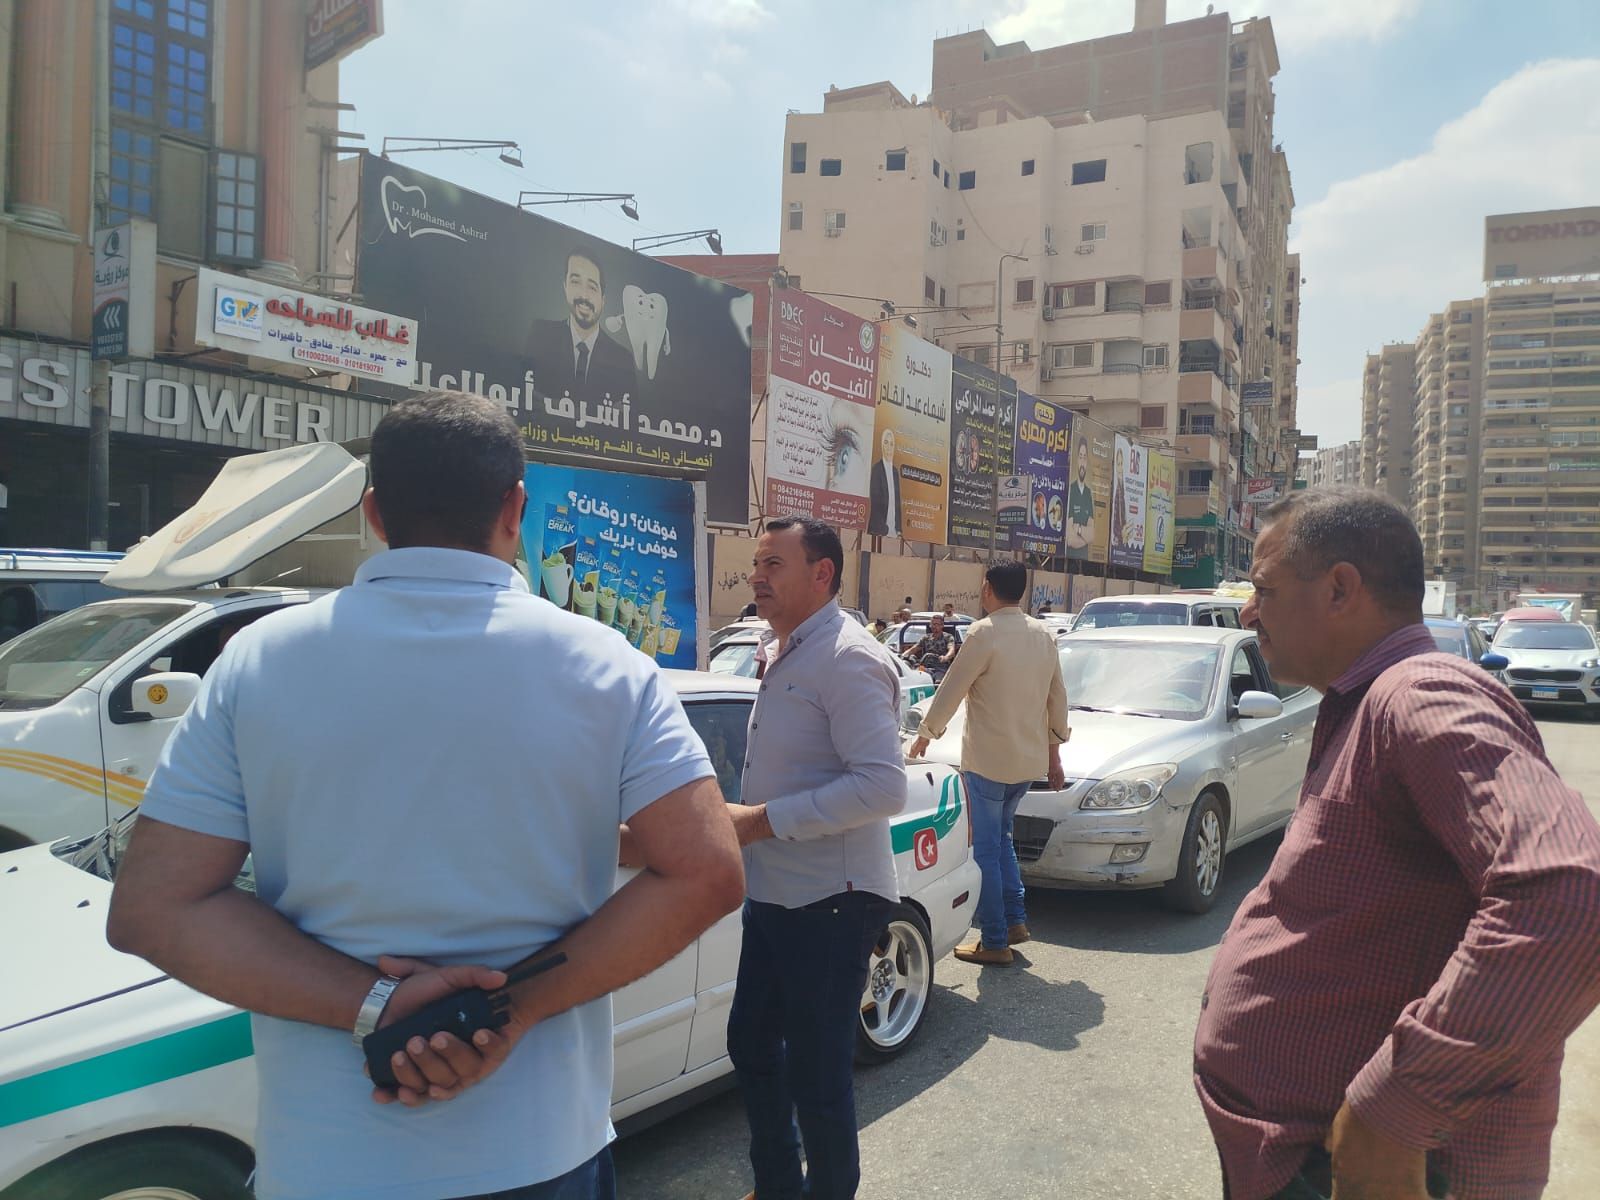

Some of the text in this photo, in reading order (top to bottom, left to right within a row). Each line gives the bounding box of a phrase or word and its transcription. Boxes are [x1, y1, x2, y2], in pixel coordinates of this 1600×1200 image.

[411, 207, 456, 231] Mohamed
[460, 224, 489, 241] Ashraf
[355, 318, 409, 345] غلاب
[823, 312, 845, 329] مركز
[809, 334, 874, 379] بستان
[906, 355, 931, 378] دكتورة
[808, 370, 872, 400] الفيوم
[543, 390, 631, 430] أشرف
[877, 381, 946, 424] شيماء عبد القادر
[552, 427, 600, 451] وتجميل
[603, 439, 633, 455] الفم
[1047, 423, 1069, 453] أكرم
[636, 443, 671, 461] جراحة
[548, 519, 575, 534] BREAK
[567, 490, 677, 541] فوقان؟ روقان؟
[599, 527, 635, 551] بريك
[576, 552, 599, 567] BREAK
[602, 562, 622, 576] BREAK
